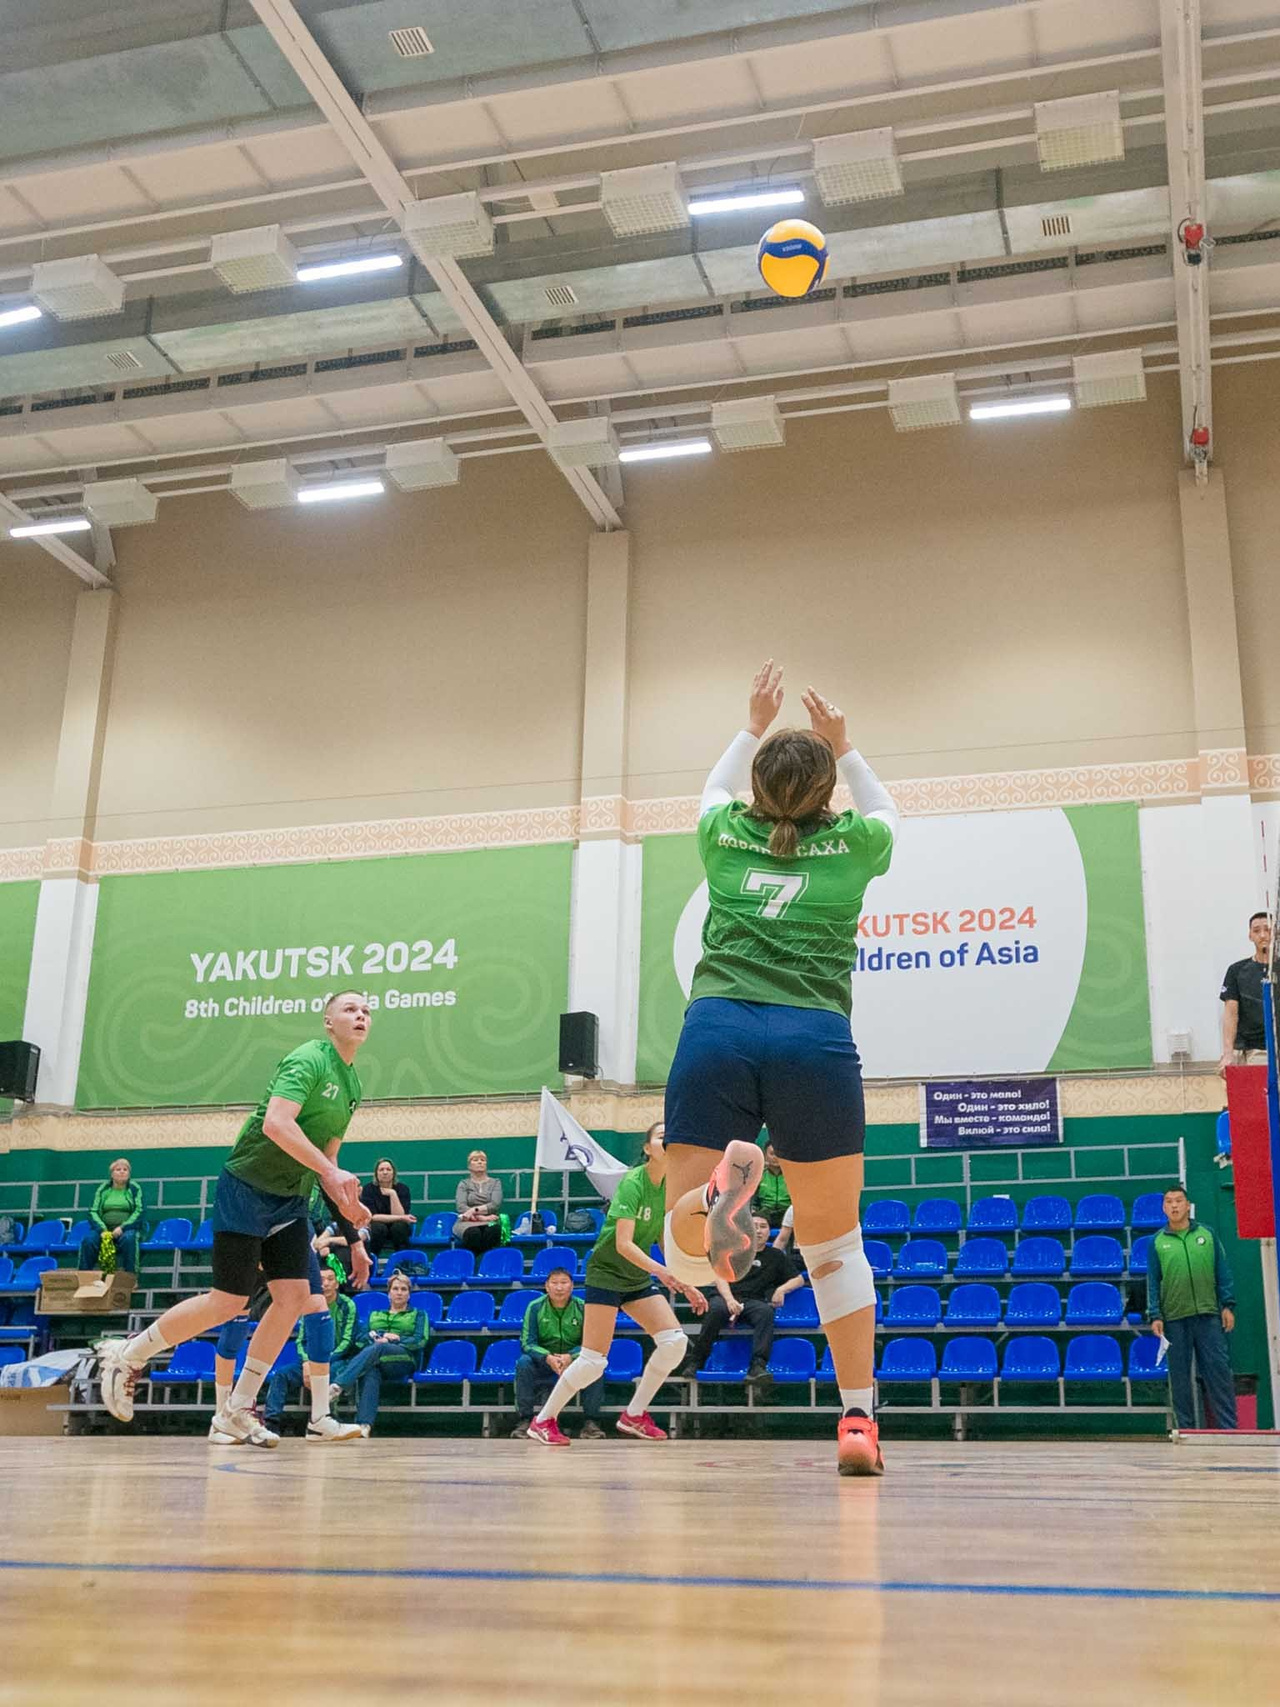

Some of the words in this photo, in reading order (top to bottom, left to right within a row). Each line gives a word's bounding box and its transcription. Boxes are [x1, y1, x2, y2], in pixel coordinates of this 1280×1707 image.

[740, 867, 809, 918] 7
[856, 911, 951, 939] KUTSK
[959, 906, 1037, 933] 2024
[190, 944, 355, 983] YAKUTSK
[362, 938, 458, 974] 2024
[939, 942, 969, 968] of
[975, 940, 1039, 966] Asia
[184, 998, 219, 1018] 8th
[224, 995, 306, 1016] Children
[384, 989, 457, 1009] Games
[322, 1082, 339, 1100] 27
[934, 1091, 963, 1101] Один
[970, 1092, 988, 1100] это
[958, 1102, 988, 1113] Один
[997, 1103, 1016, 1111] это
[934, 1115, 953, 1124] Мы
[998, 1111, 1051, 1122] команда!
[958, 1125, 994, 1135] Вилюй
[1002, 1126, 1020, 1134] это
[637, 1206, 651, 1221] 18
